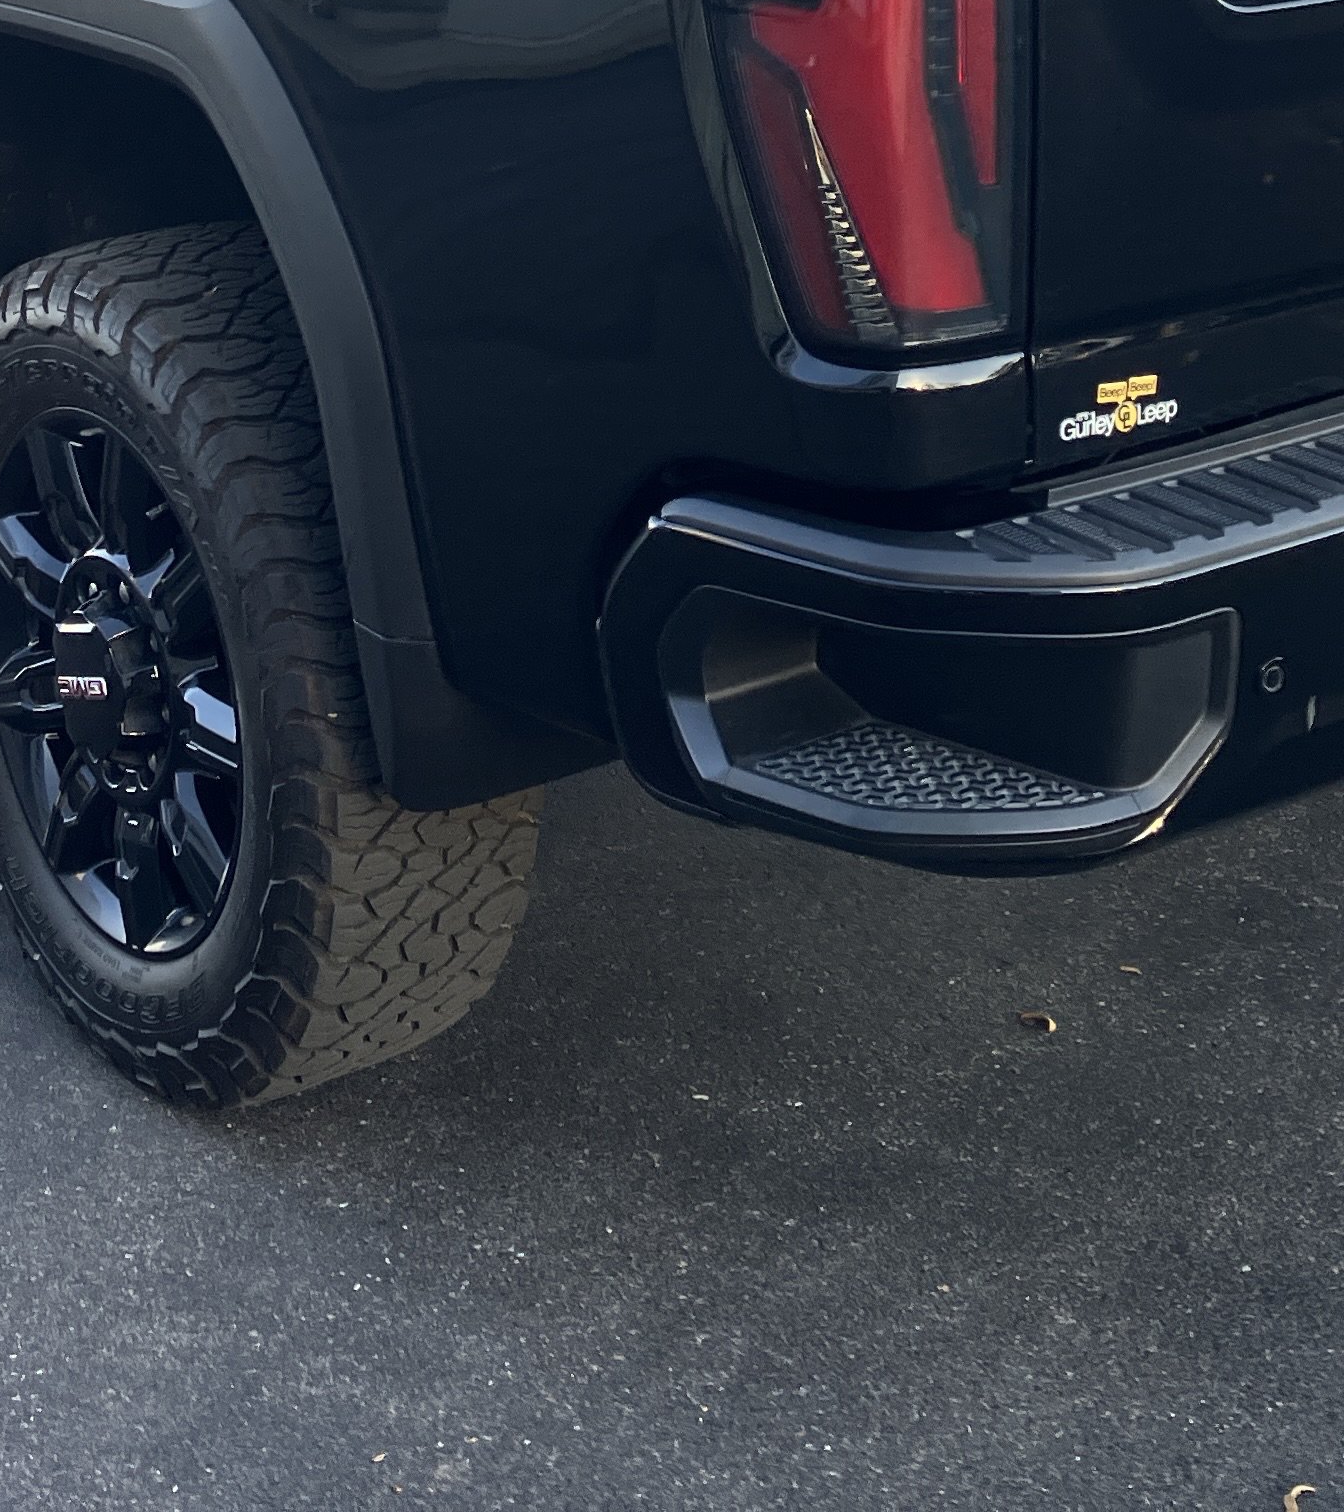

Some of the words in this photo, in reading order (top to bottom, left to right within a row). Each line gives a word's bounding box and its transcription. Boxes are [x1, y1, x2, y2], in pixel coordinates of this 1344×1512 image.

[1060, 411, 1116, 441] Gurley
[1136, 399, 1177, 425] Leep
[58, 676, 107, 700] GMC
